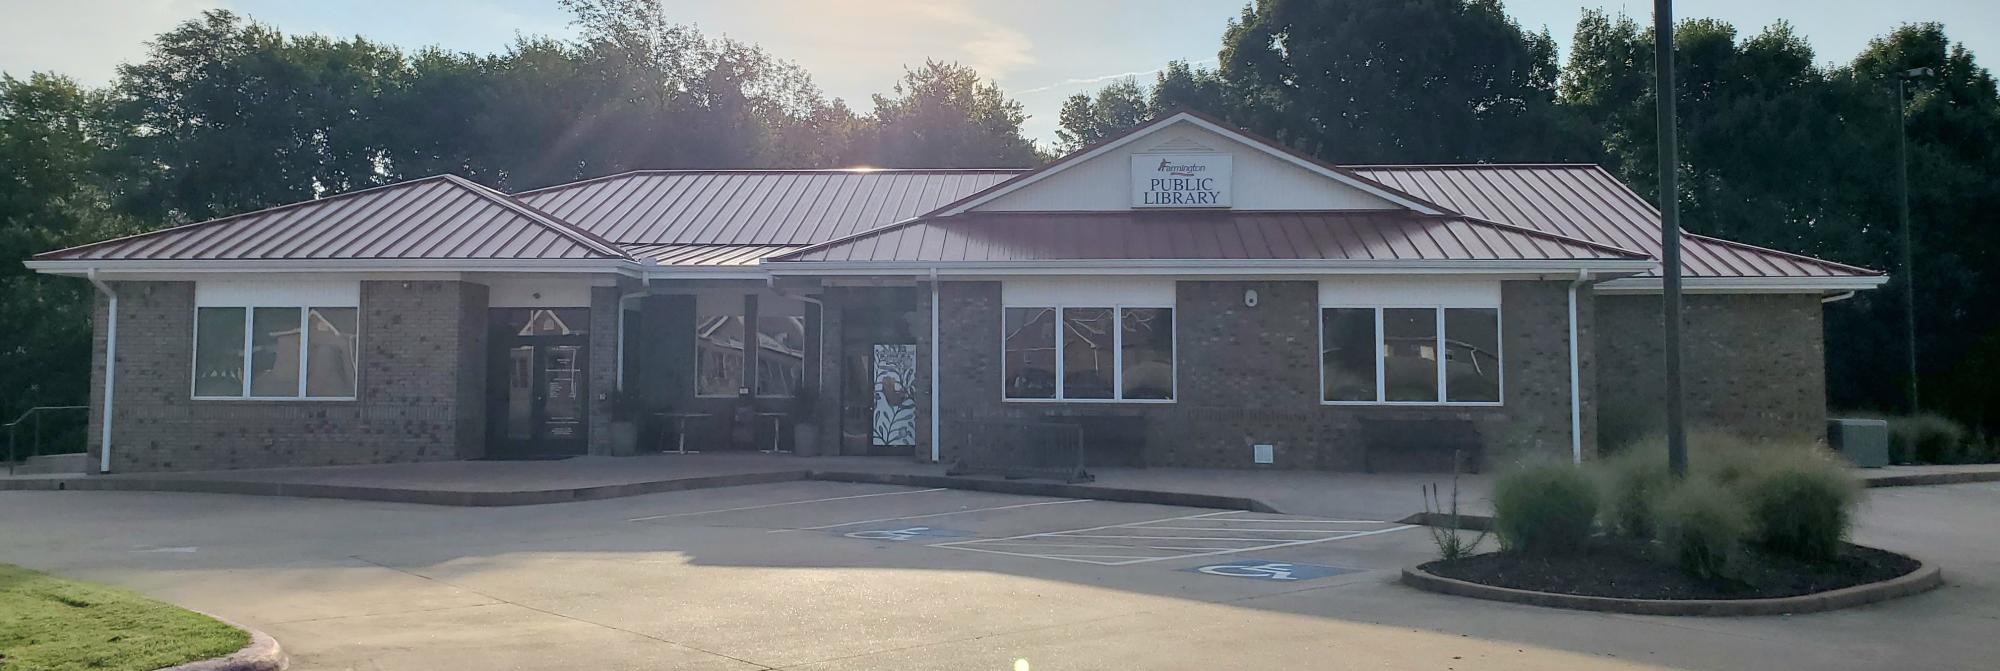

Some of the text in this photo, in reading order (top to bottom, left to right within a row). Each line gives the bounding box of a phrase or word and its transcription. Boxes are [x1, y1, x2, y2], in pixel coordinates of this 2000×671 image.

[1157, 158, 1206, 174] Farmington
[1151, 178, 1213, 191] PUBLIC
[1144, 191, 1220, 205] LIBRARY
